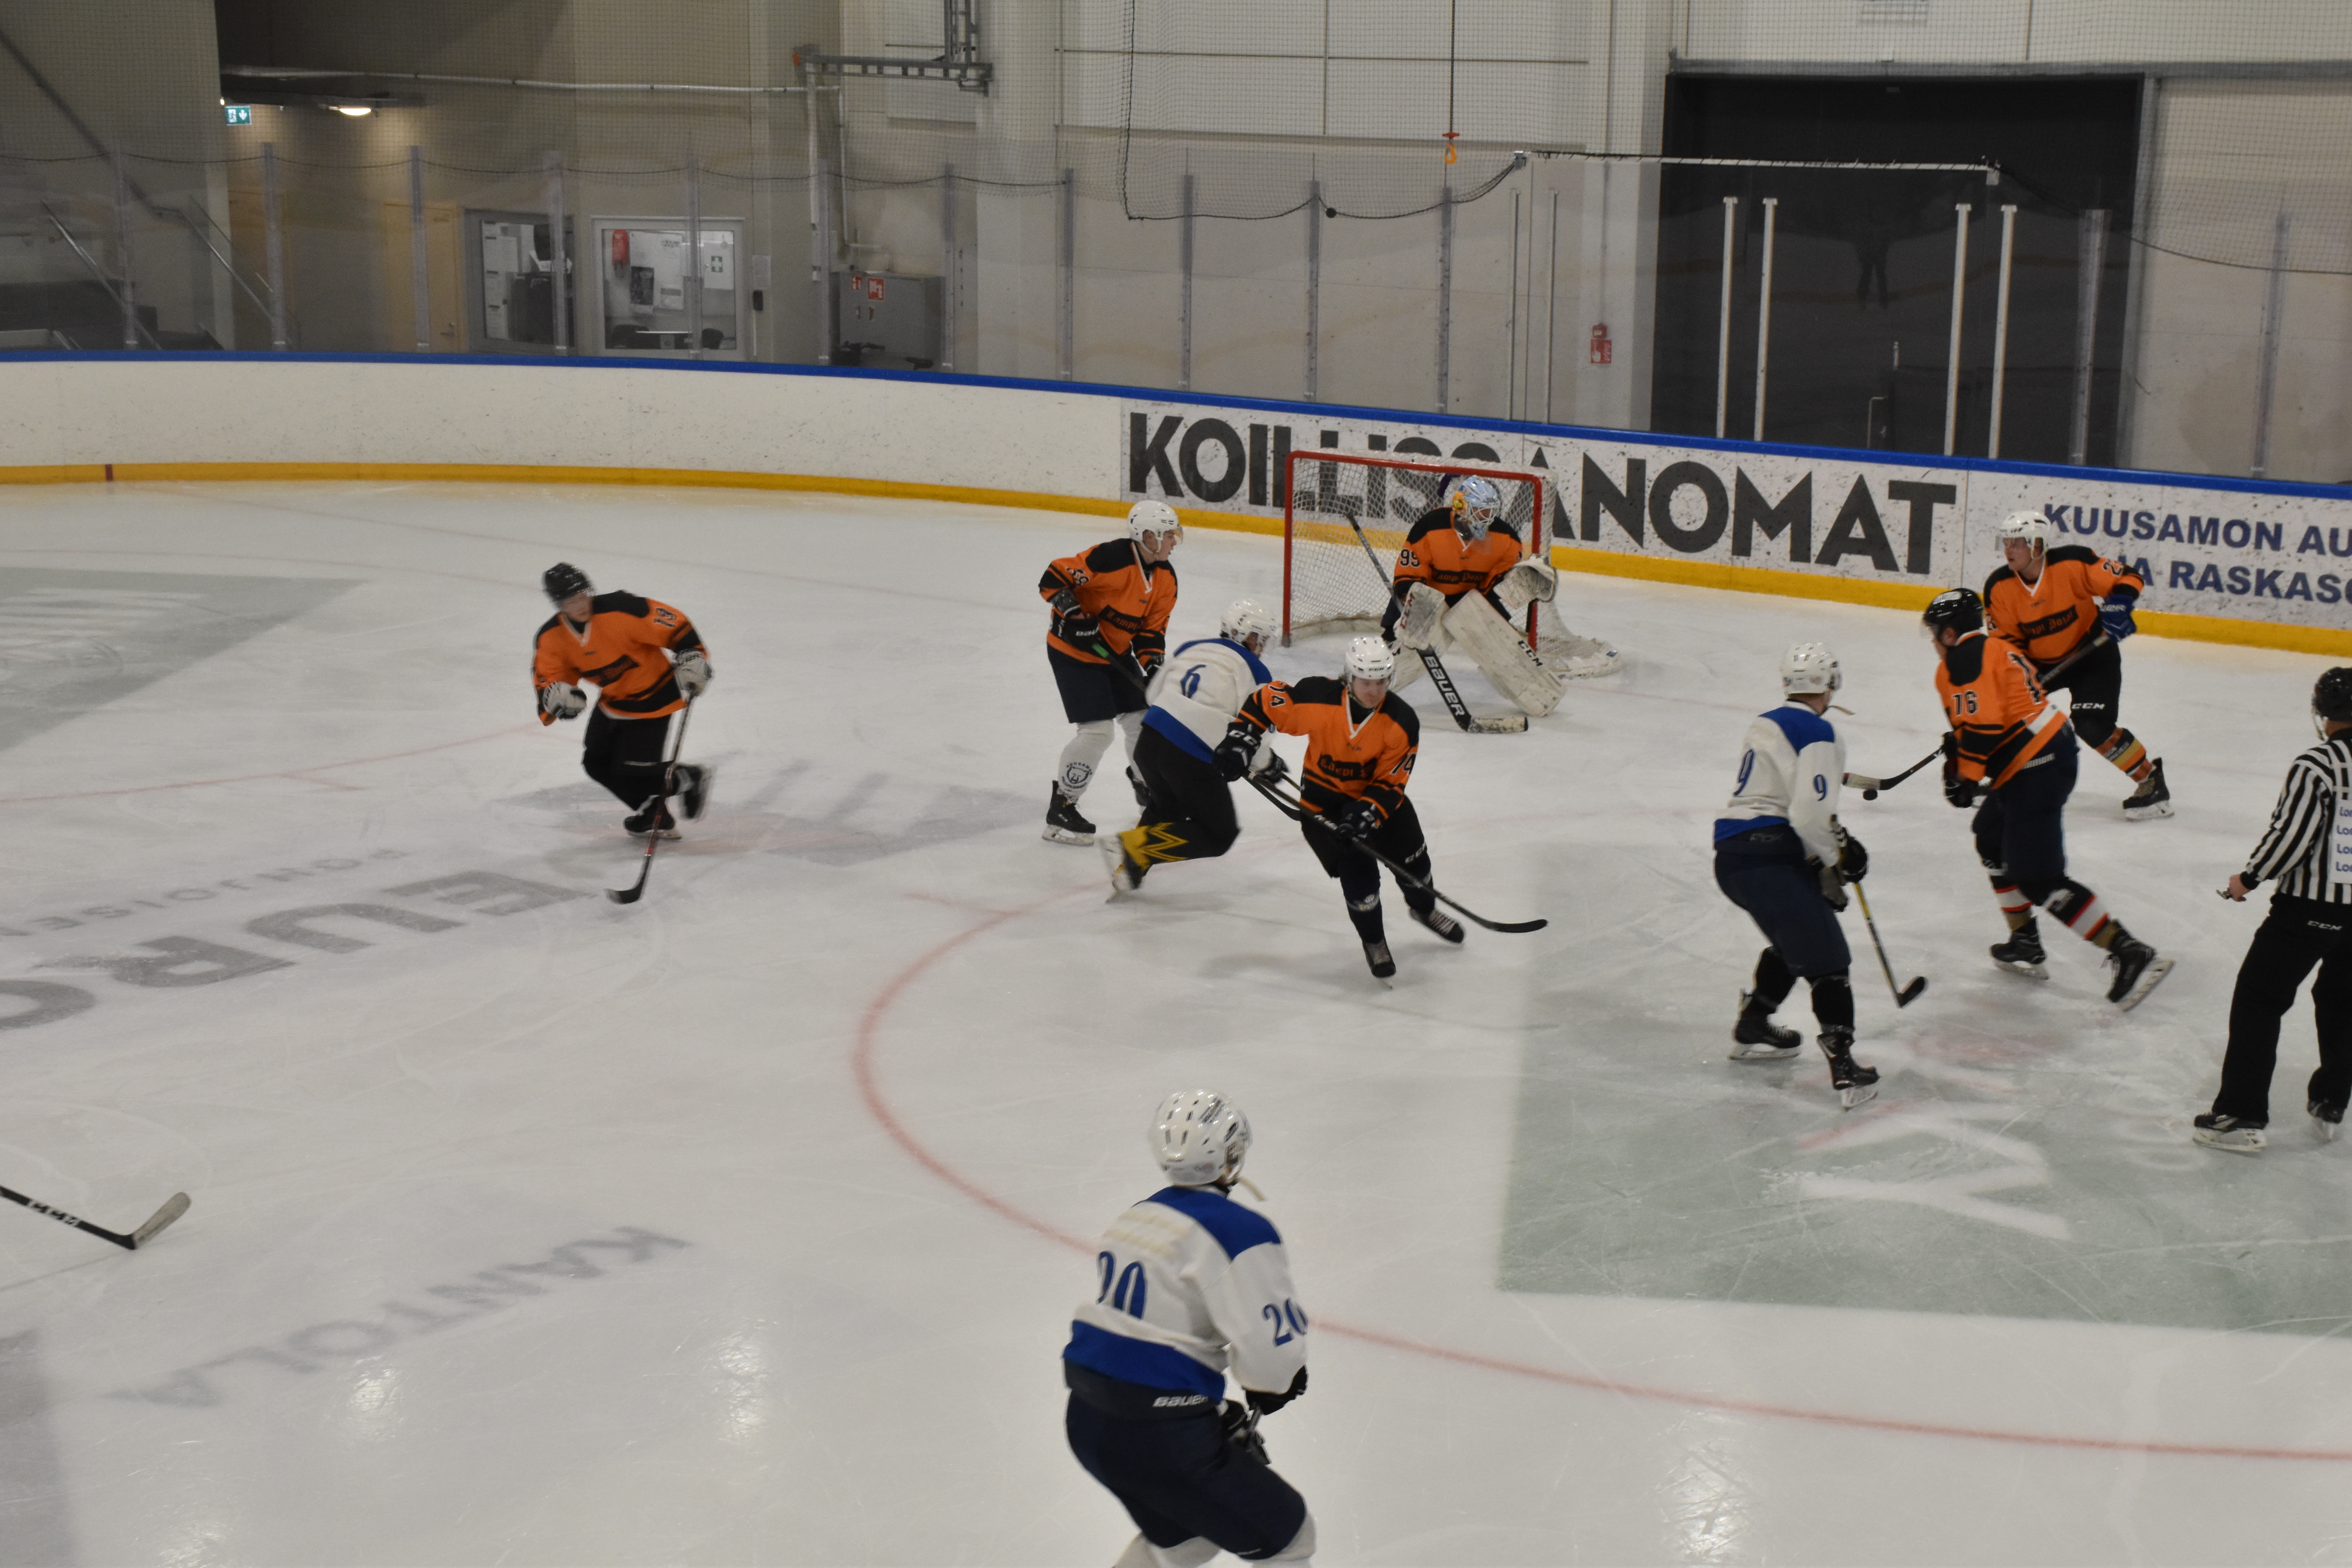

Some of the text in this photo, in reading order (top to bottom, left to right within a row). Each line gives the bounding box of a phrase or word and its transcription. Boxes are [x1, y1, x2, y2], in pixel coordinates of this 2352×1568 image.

[2044, 503, 2283, 551] KUUSAMON
[2118, 555, 2352, 604] A RASKAS
[1518, 640, 1543, 667] CCM
[1180, 664, 1206, 699] 6
[1424, 656, 1465, 717] BAUER
[1812, 774, 1827, 801] 9
[2308, 920, 2342, 931] CCM
[1263, 1298, 1308, 1347] 20
